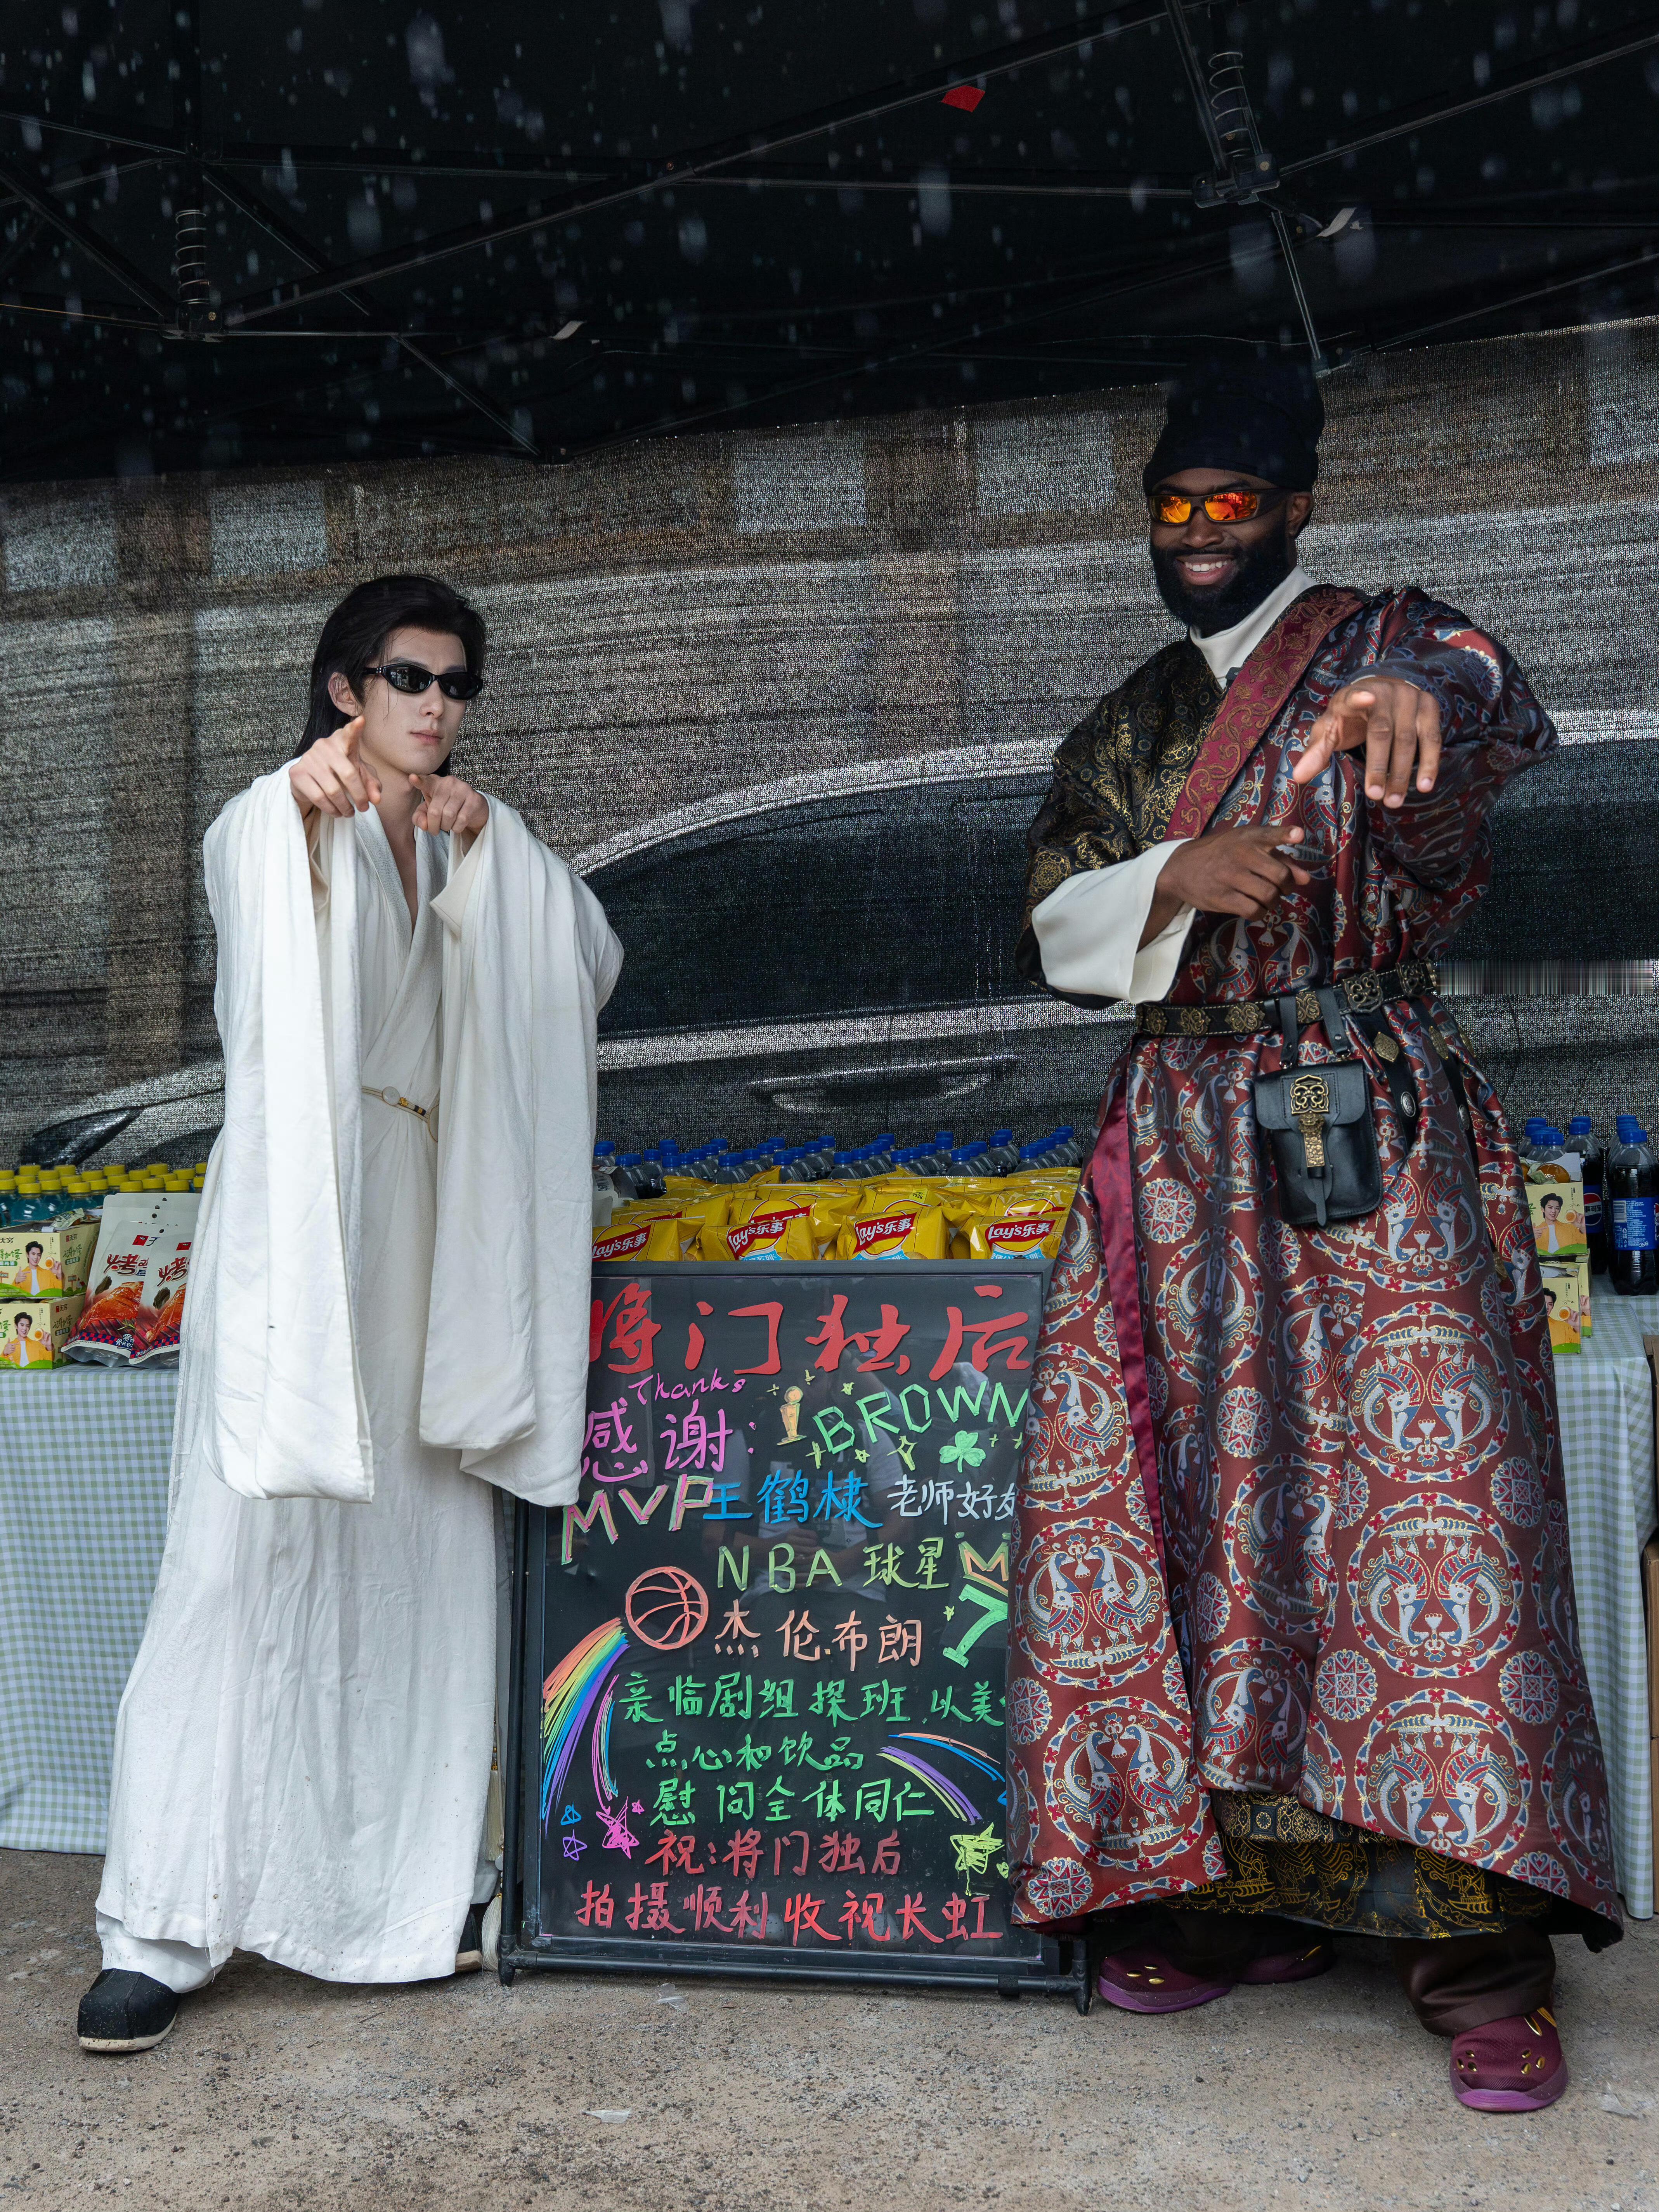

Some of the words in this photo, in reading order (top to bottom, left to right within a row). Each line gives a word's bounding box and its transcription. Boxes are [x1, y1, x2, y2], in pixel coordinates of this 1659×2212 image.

[592, 1239, 621, 1259] Lay's
[620, 1232, 647, 1251] 乐事
[728, 1227, 756, 1253] Lay's
[755, 1222, 784, 1235] 乐事
[856, 1222, 884, 1245] Lay's
[882, 1218, 912, 1235] 乐事
[988, 1225, 1022, 1241] Lay's
[1021, 1223, 1051, 1237] 乐事
[628, 1368, 745, 1405] Thanks
[812, 1380, 1029, 1454] BROWN
[562, 1474, 714, 1565] MVP
[703, 1469, 884, 1529] 王鹤棣
[717, 1543, 843, 1594] NBA
[863, 1537, 949, 1590] 球星
[646, 1729, 864, 1771] 点心和饮品
[650, 1775, 934, 1826] 慰问全体同仁
